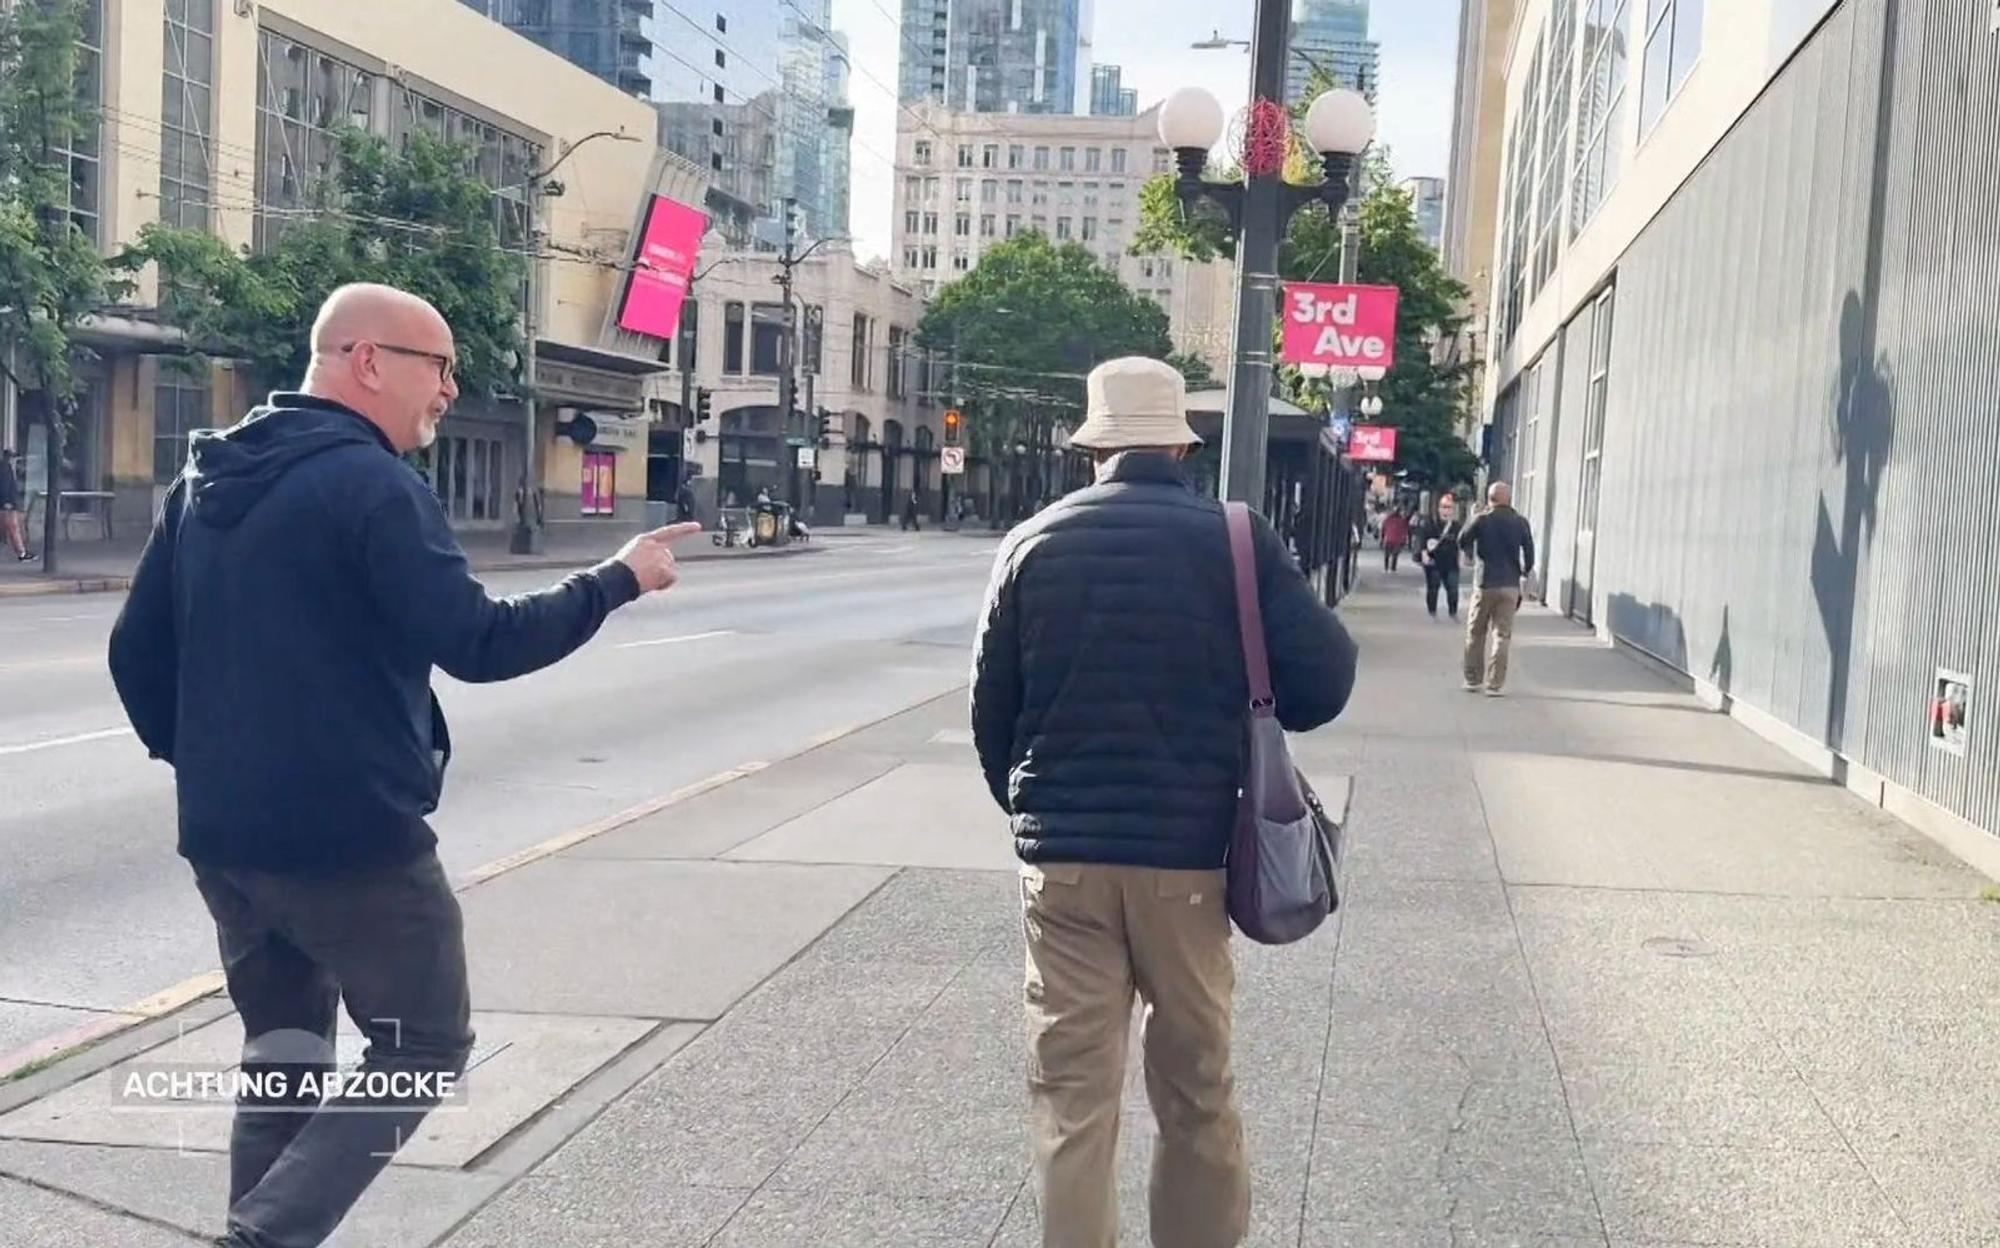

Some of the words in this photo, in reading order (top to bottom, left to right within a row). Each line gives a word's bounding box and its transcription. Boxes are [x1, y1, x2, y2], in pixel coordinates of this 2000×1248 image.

[1292, 292, 1356, 325] 3rd
[1313, 327, 1385, 359] Ave
[1353, 430, 1381, 444] 3rd
